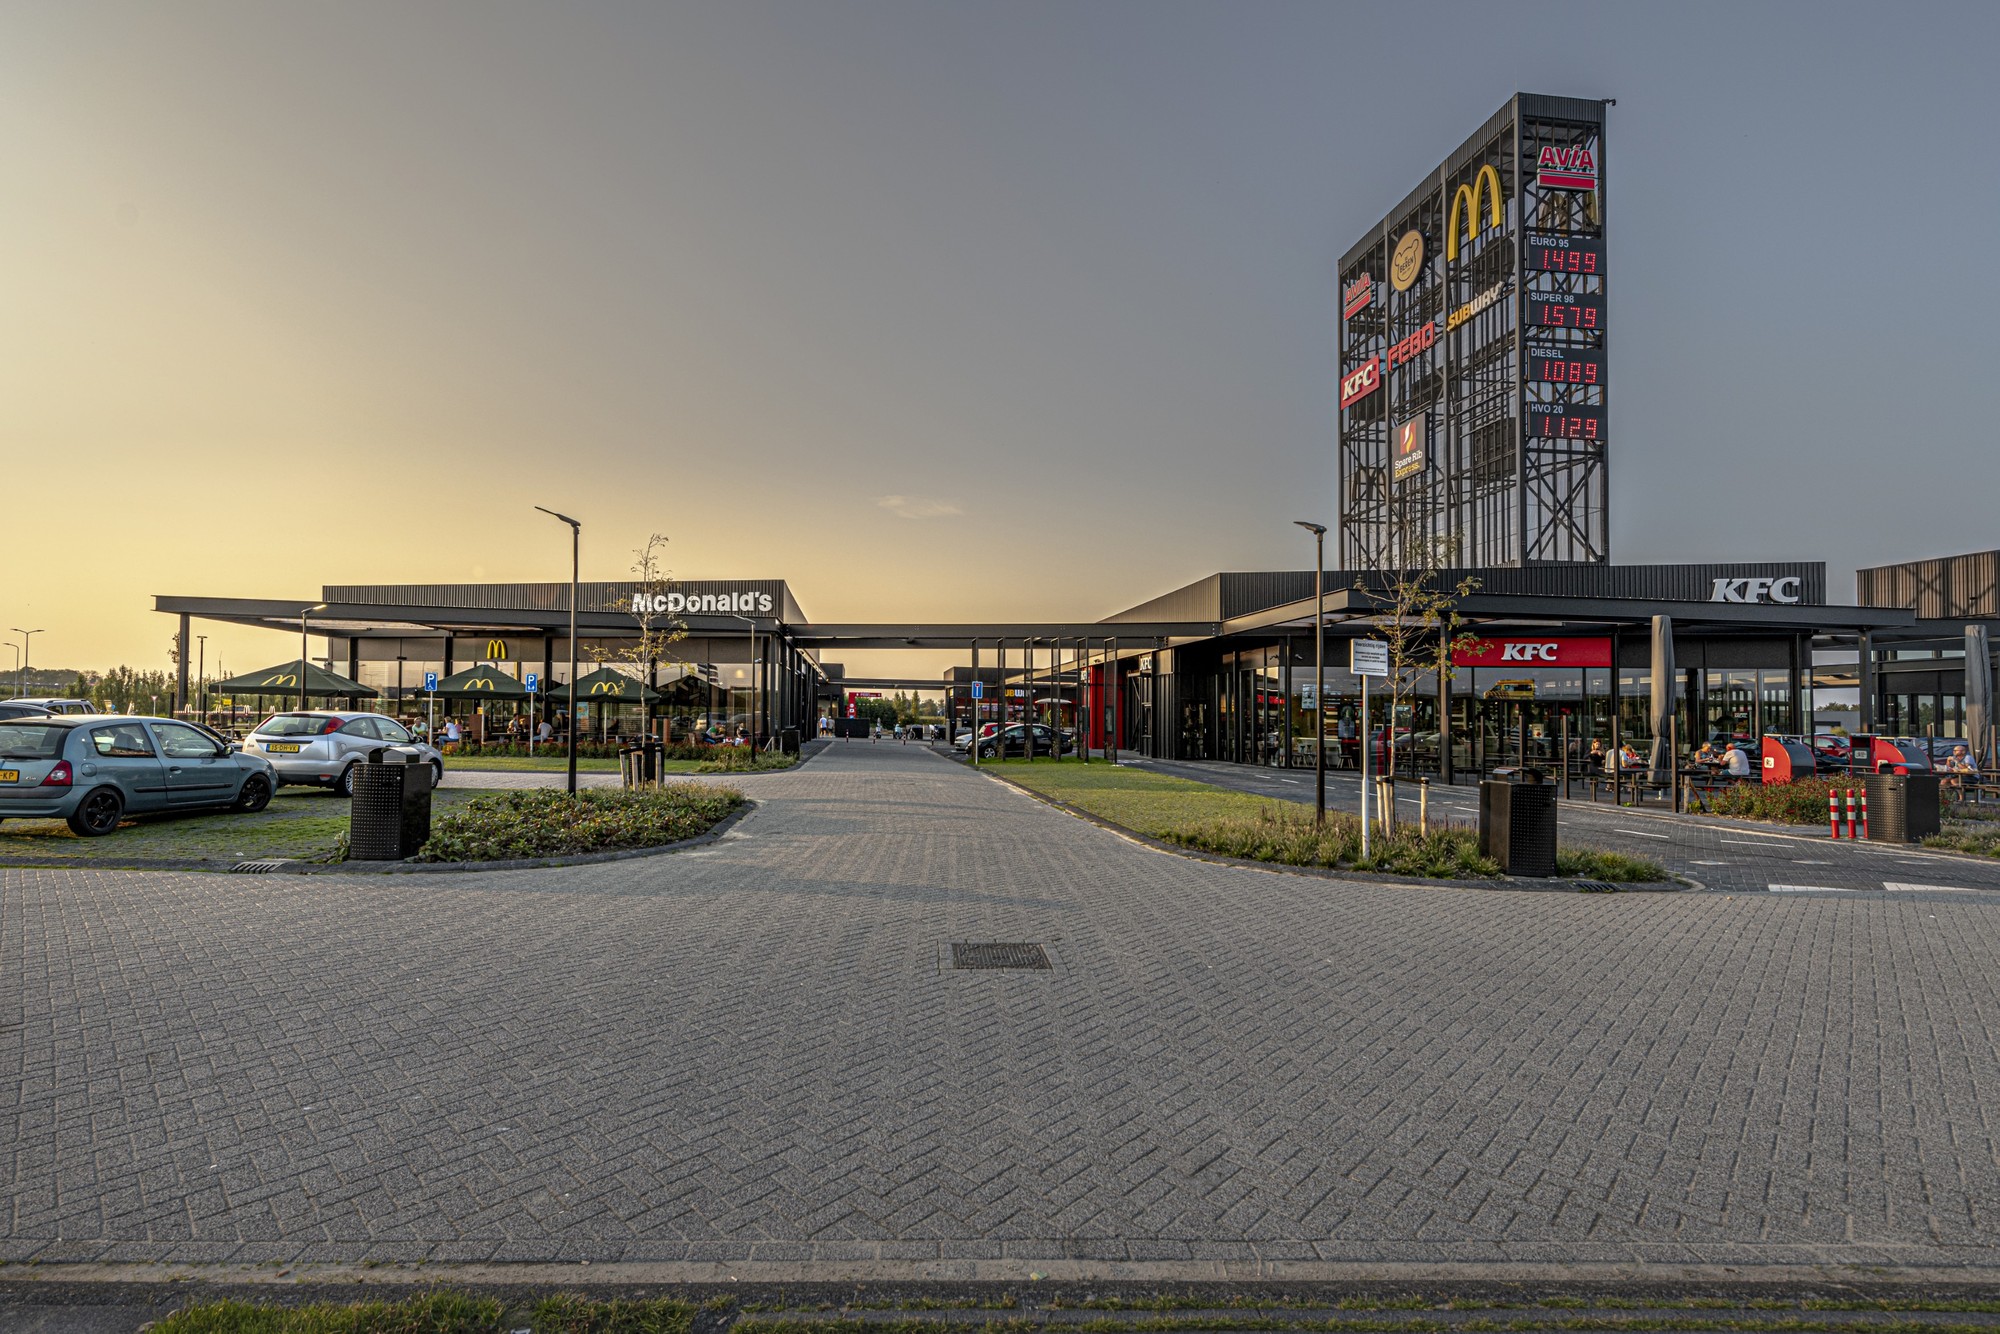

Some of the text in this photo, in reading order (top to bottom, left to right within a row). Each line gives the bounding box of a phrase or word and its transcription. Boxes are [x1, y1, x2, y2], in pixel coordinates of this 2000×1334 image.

[1530, 237, 1569, 248] EURO 95
[1543, 249, 1596, 272] 1.499
[1446, 280, 1505, 332] SUBWAY
[1530, 292, 1575, 304] SUPER 98
[1543, 305, 1597, 328] 1.579
[1387, 321, 1435, 372] FEBO
[1531, 348, 1564, 358] DIESEL
[1343, 364, 1374, 401] KFC
[1544, 360, 1597, 383] 1.089
[1531, 404, 1563, 414] HVO 20
[1544, 416, 1597, 439] 1.129
[1394, 449, 1423, 469] Spare Rib
[1710, 577, 1800, 604] KFC
[631, 591, 773, 613] McDonald's
[1500, 642, 1558, 661] KFC
[427, 673, 435, 684] P
[527, 675, 535, 685] P
